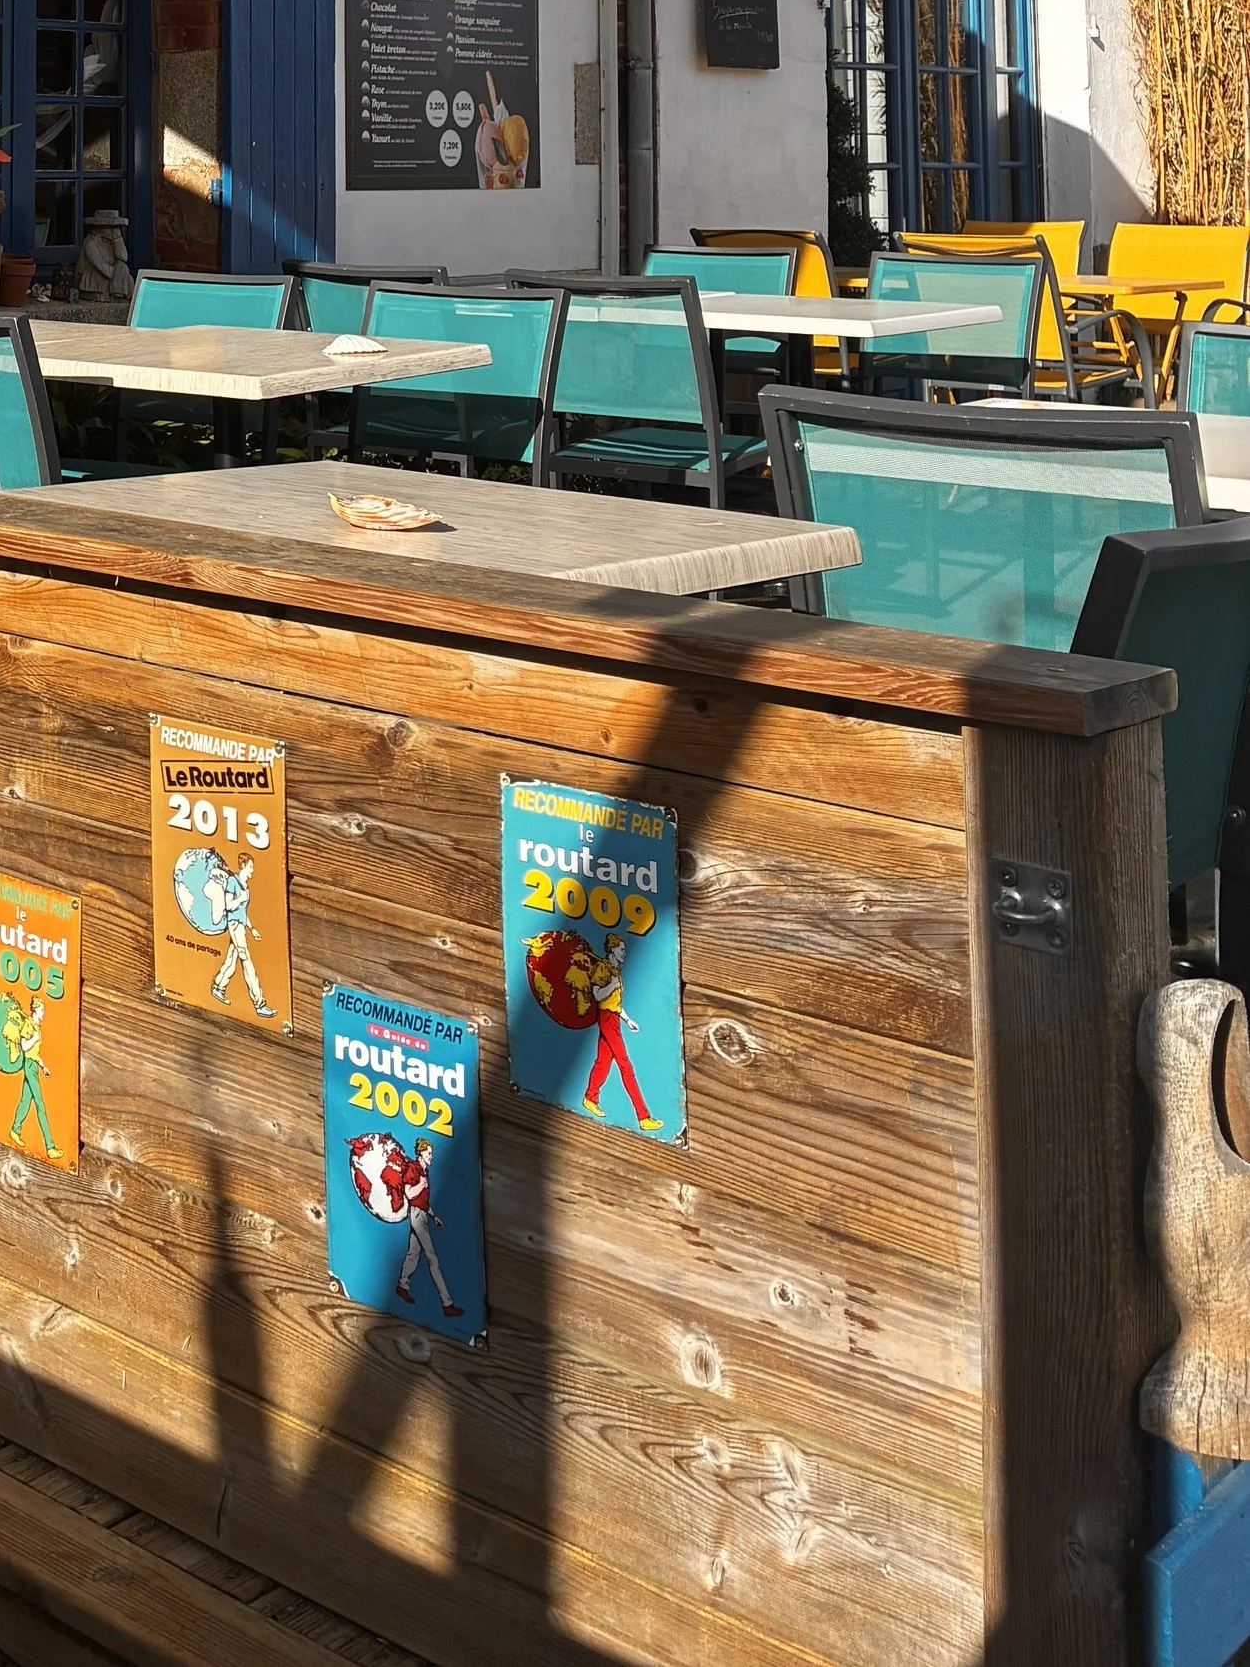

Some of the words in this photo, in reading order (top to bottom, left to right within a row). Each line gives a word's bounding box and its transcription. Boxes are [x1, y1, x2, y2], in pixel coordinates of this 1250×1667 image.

[370, 1, 397, 13] Chocolat
[370, 22, 393, 34] Nougat
[371, 63, 395, 74] Pistache
[371, 84, 385, 95] Rose
[371, 133, 391, 144] Yaourt
[248, 744, 274, 768] PAR
[167, 794, 270, 849] 2013
[514, 788, 626, 831] RECOMMANDÉ
[630, 813, 664, 840] PAR
[579, 823, 594, 843] le
[519, 837, 658, 894] routard
[522, 869, 656, 936] 2009
[16, 905, 27, 922] le
[175, 938, 186, 947] ans
[187, 941, 195, 949] de
[196, 944, 222, 957] partage
[336, 992, 433, 1037] RECOMMANDÉ
[434, 1021, 463, 1045] PAR
[383, 1029, 411, 1046] Guide
[415, 1039, 426, 1050] du
[335, 1033, 465, 1098] routard
[348, 1072, 454, 1137] 2002
